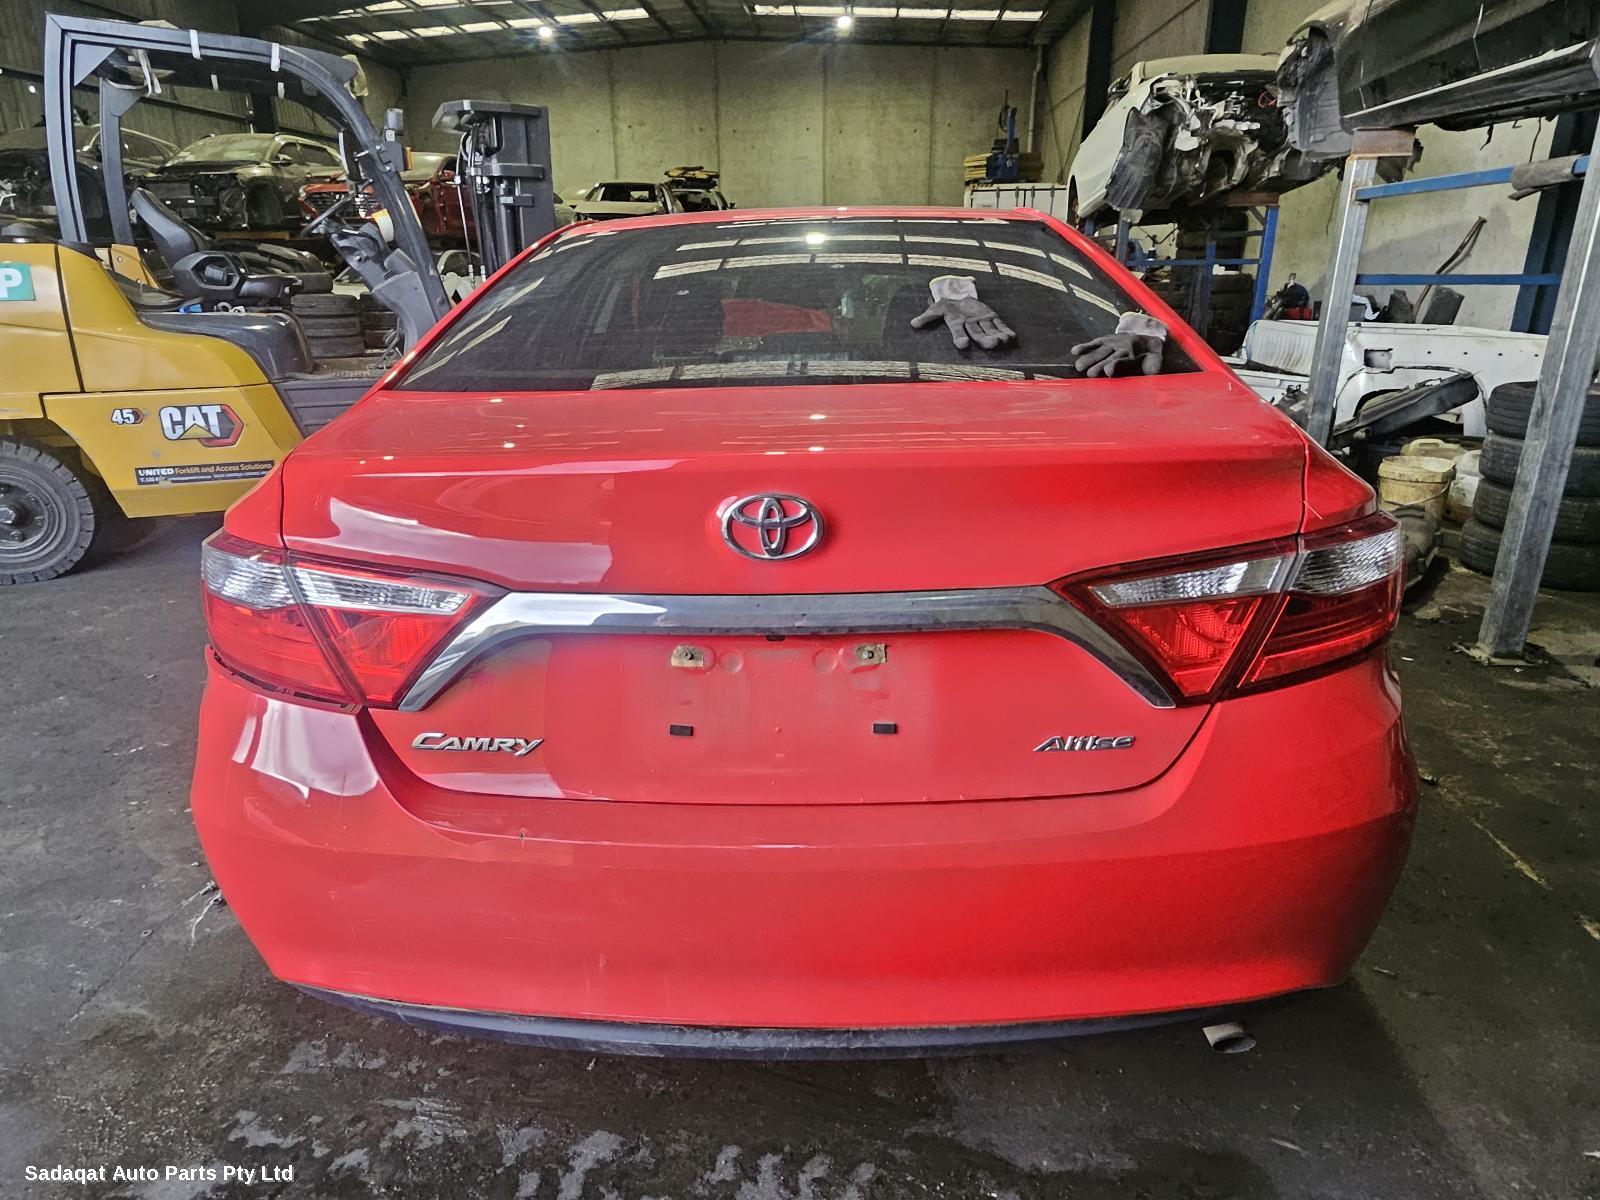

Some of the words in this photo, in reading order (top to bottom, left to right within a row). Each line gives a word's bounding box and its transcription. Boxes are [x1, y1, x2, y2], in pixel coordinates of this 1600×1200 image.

[112, 409, 135, 424] 45
[160, 405, 222, 440] CAT
[138, 467, 174, 477] UNITED
[175, 466, 200, 475] Forklift
[201, 465, 215, 473] and
[216, 464, 239, 473] Access
[240, 463, 272, 471] Solutions
